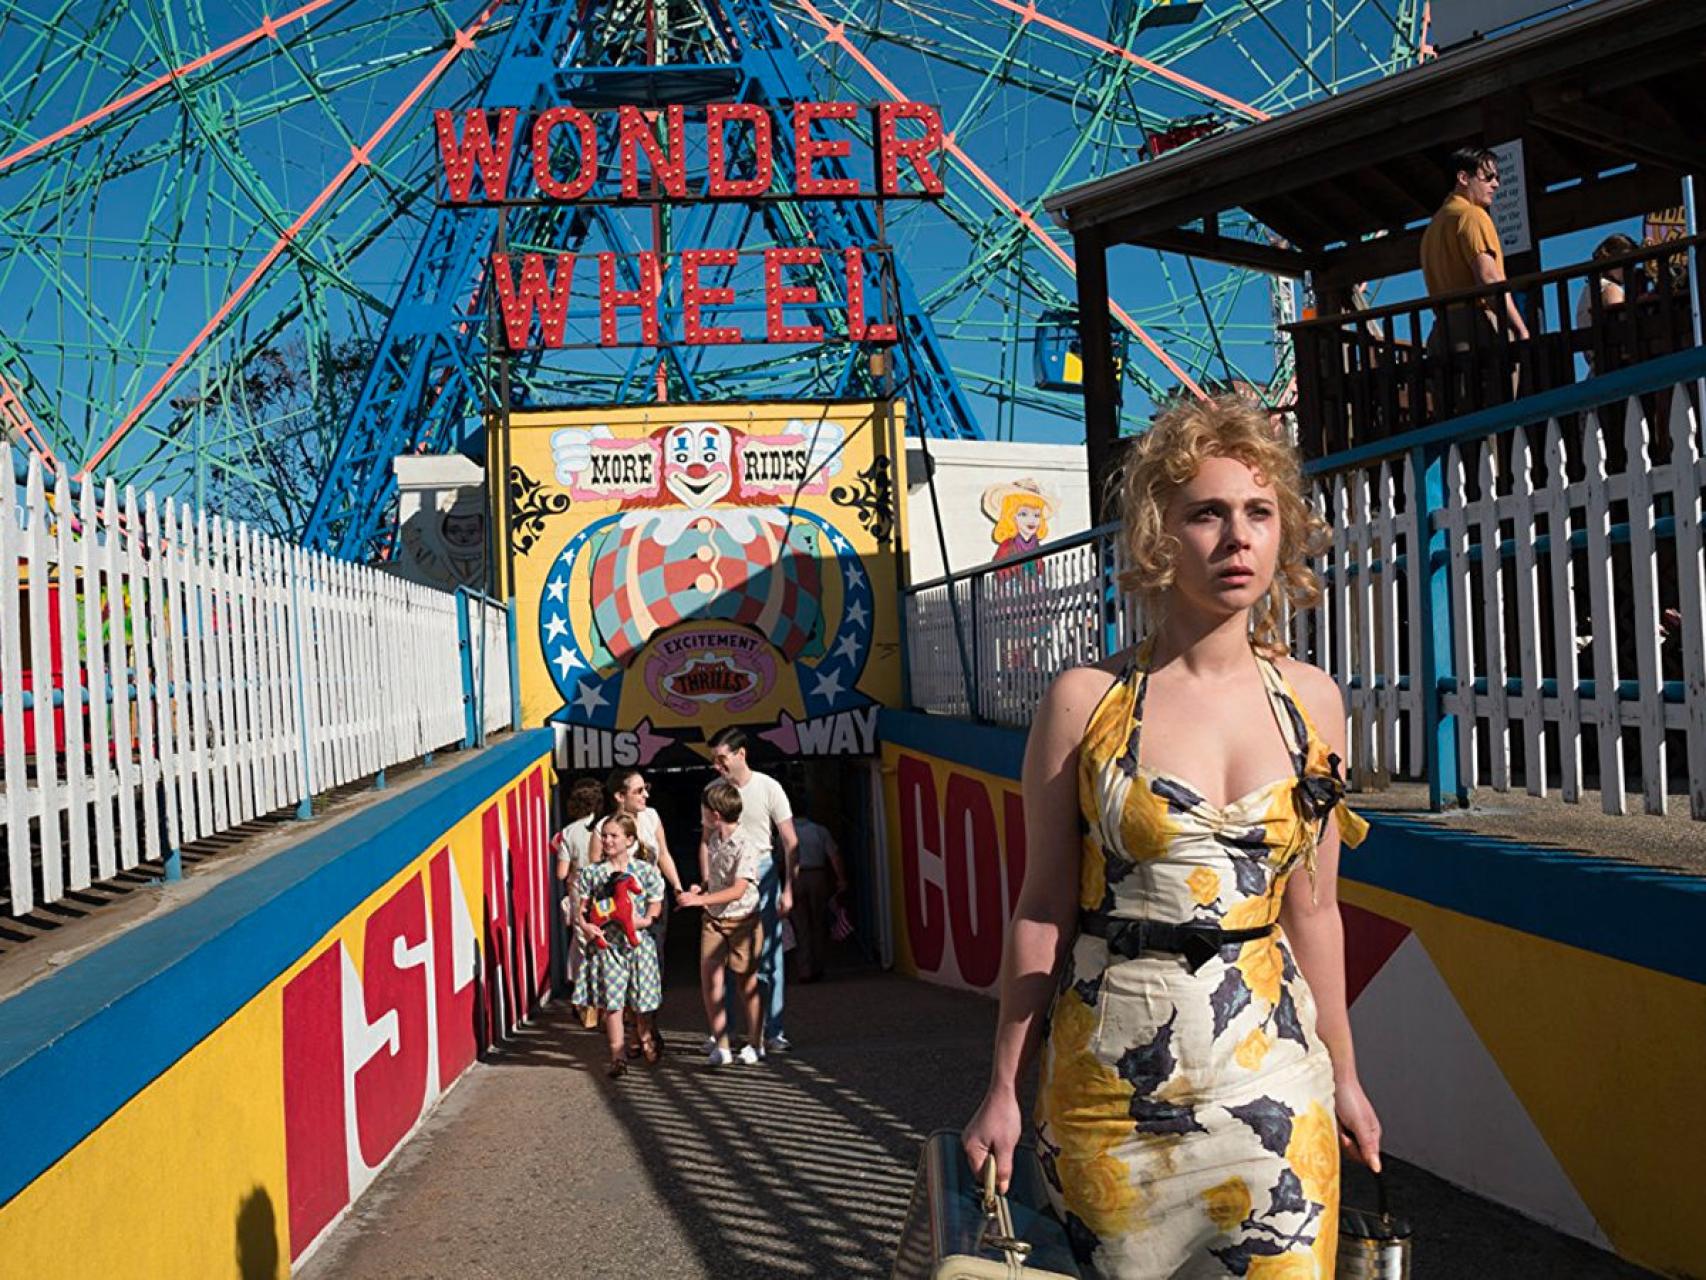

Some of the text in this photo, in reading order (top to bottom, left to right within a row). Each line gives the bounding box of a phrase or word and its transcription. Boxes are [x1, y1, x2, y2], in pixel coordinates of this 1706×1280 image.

[434, 102, 945, 201] WONDER
[492, 247, 898, 349] WHEEL
[591, 449, 807, 485] MORE RIDES
[663, 633, 759, 655] EXCITEMENT
[677, 669, 745, 693] THRILLS
[551, 704, 881, 770] THIS WAY
[283, 764, 552, 1264] ISLAND
